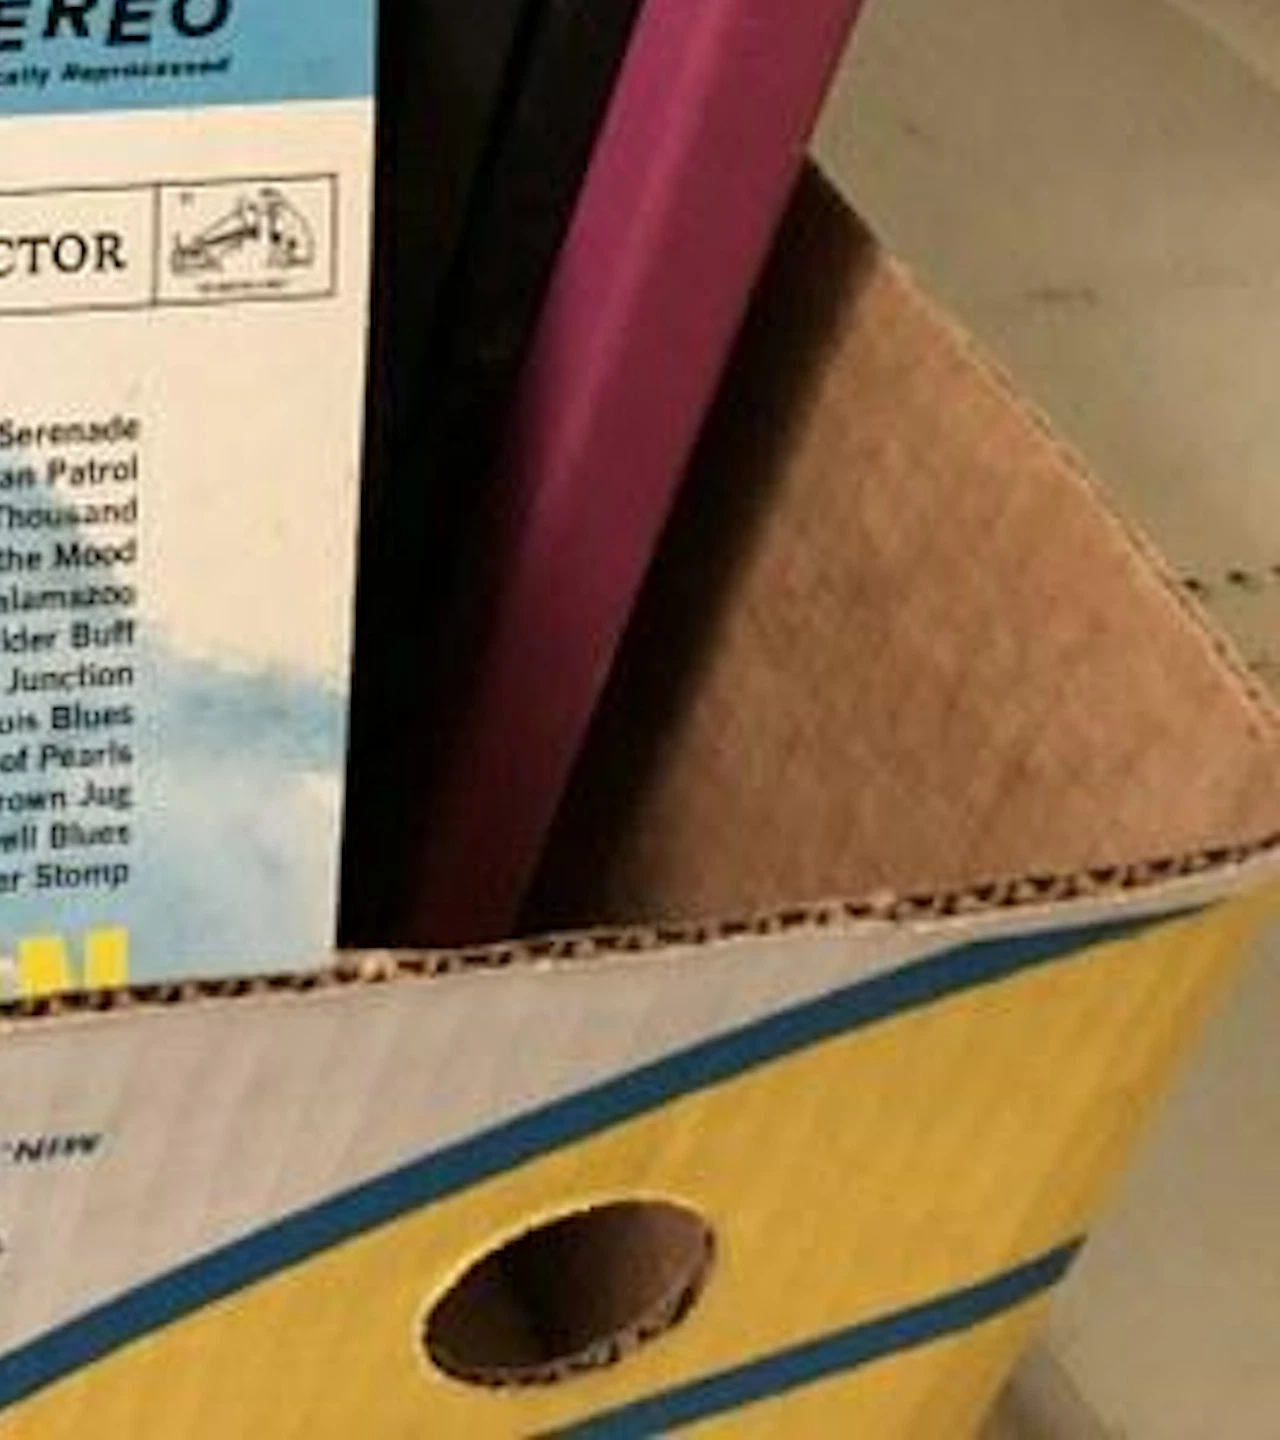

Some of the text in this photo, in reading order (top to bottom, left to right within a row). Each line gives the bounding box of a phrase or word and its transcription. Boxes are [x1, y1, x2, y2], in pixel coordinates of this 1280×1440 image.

[48, 455, 138, 487] Patrol
[52, 540, 137, 570] Mood
[71, 619, 136, 650] Buff
[5, 664, 134, 696] Junction
[51, 701, 133, 731] Blues
[0, 745, 31, 774] of
[41, 740, 133, 769] Pearls
[79, 781, 133, 811] Jug
[50, 822, 130, 851] Blues
[34, 862, 130, 892] Stomp
[1, 1131, 103, 1162] MIN.
